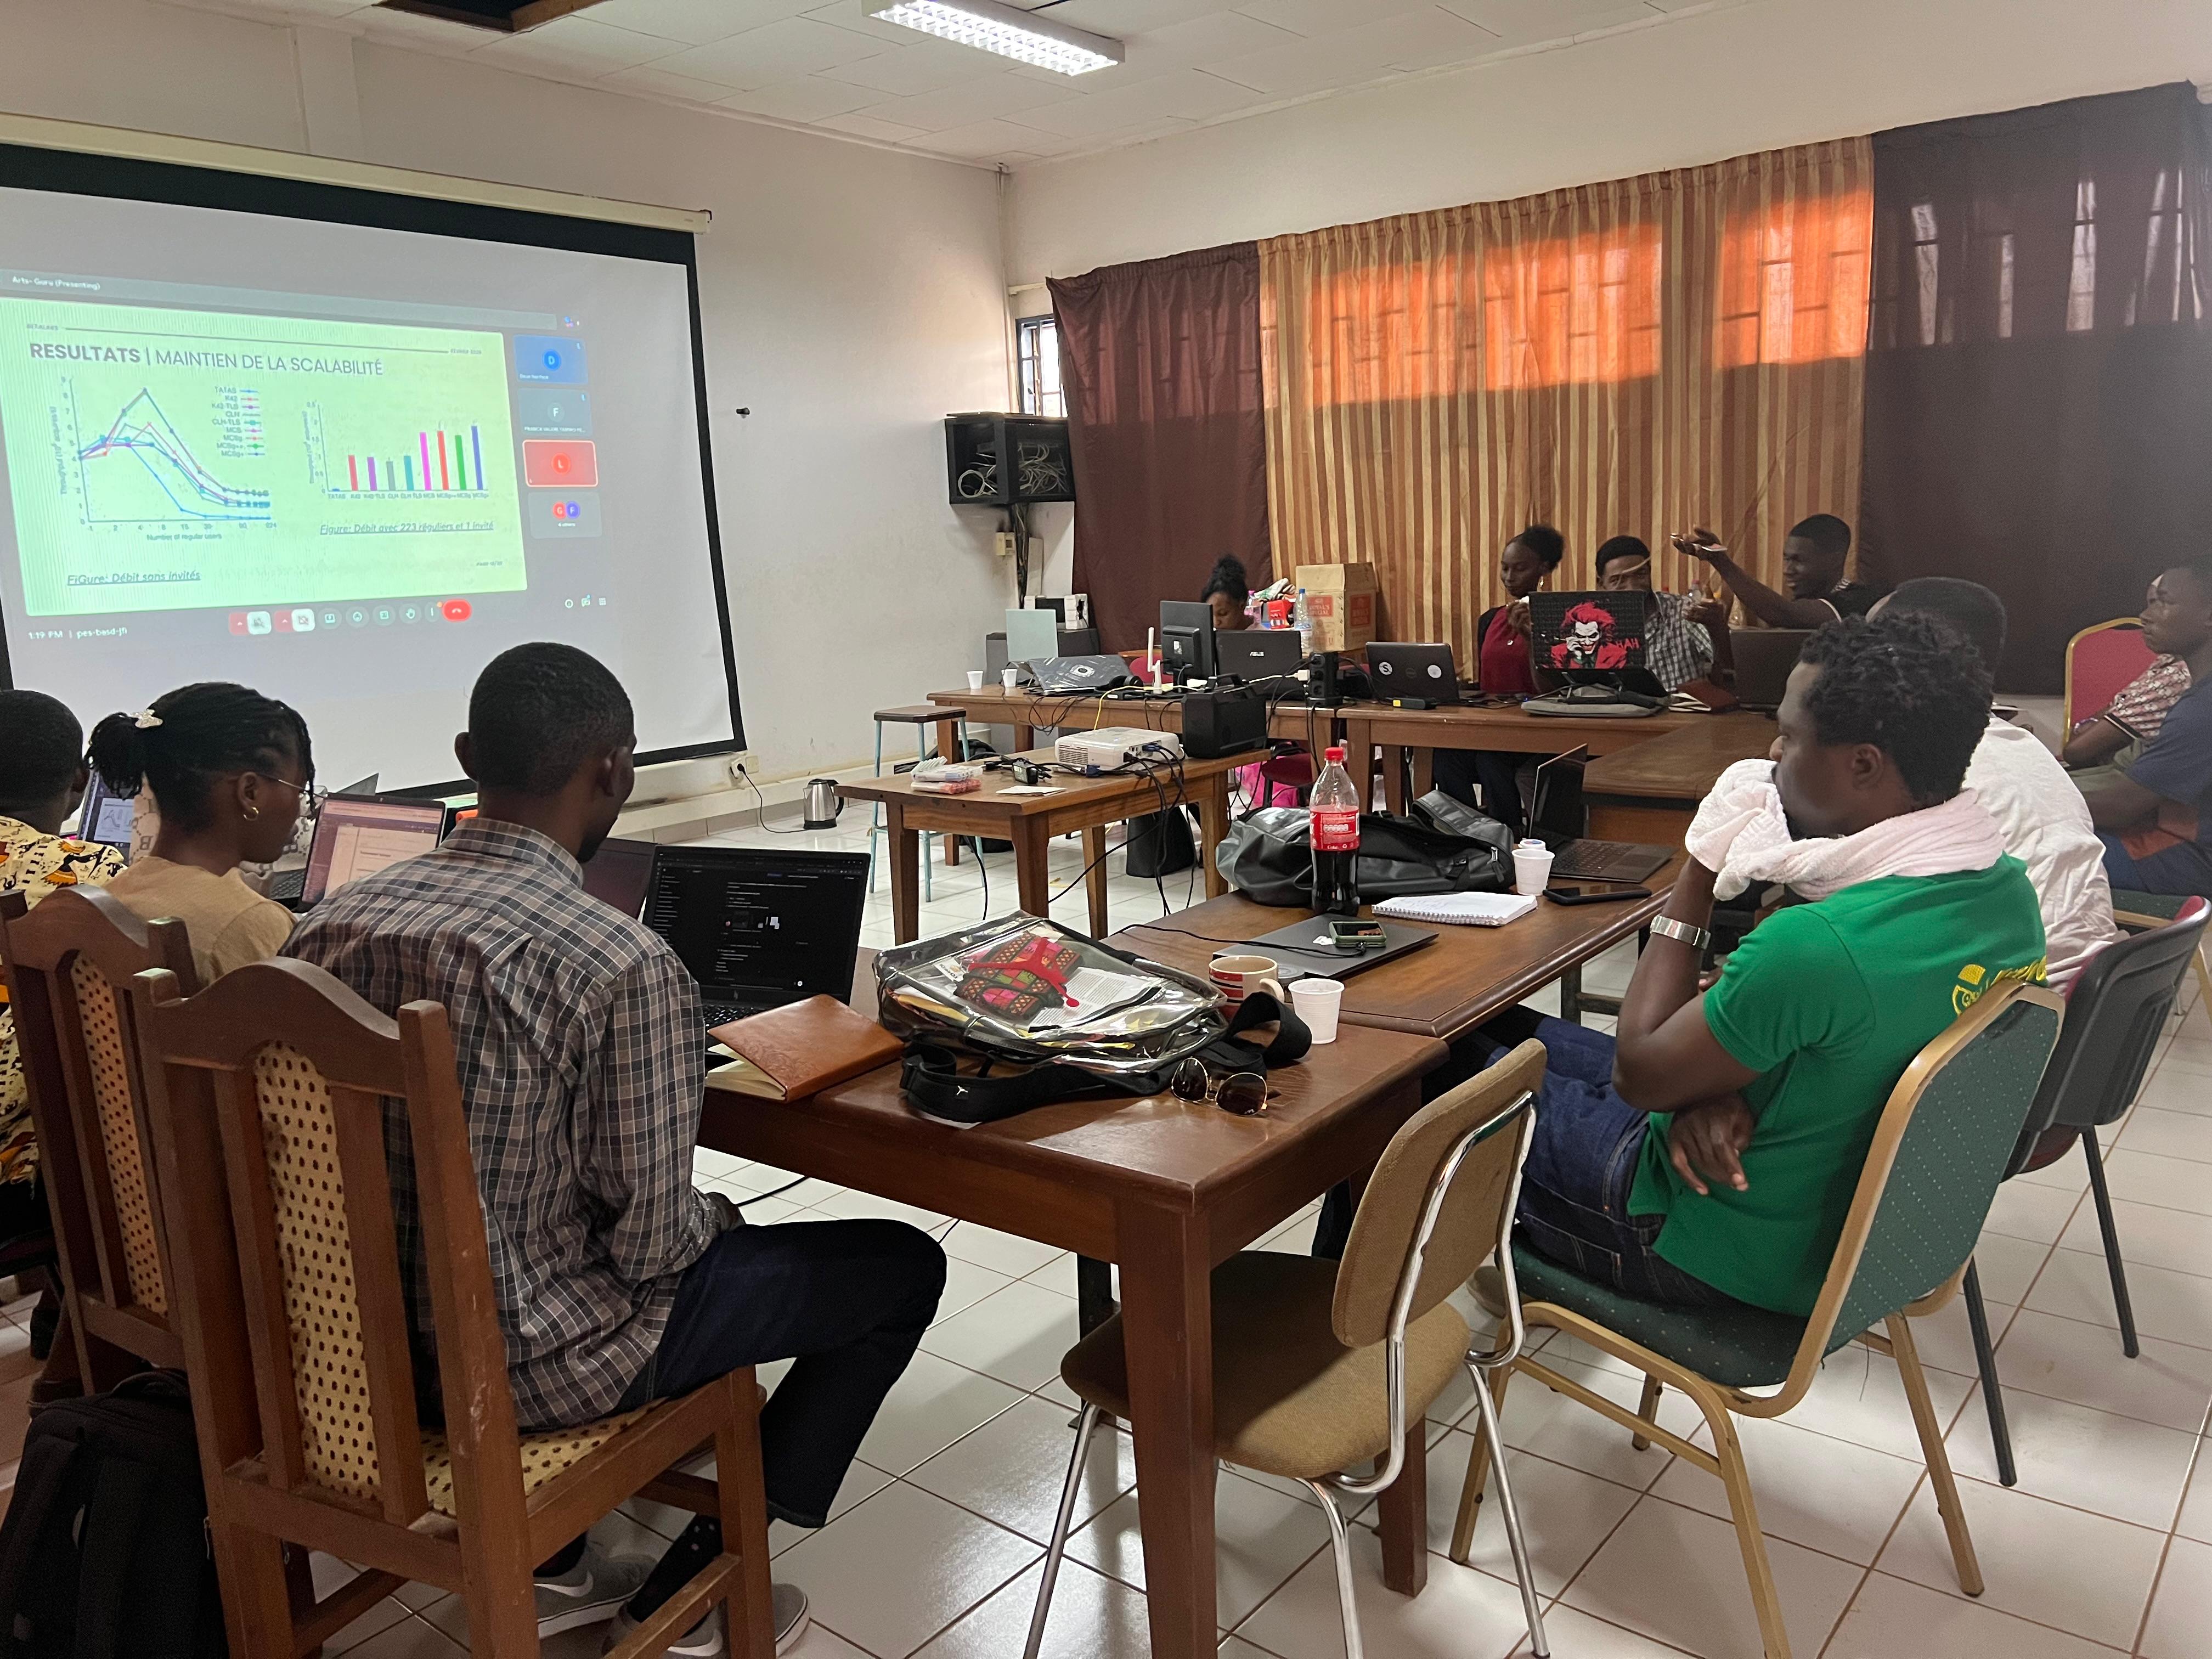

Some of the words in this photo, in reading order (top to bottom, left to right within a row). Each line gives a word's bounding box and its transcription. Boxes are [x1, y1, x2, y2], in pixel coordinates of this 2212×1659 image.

[30, 343, 140, 363] RESULTATS
[155, 349, 237, 368] MAINTIEN
[242, 354, 264, 369] DE
[268, 356, 287, 371] LA
[290, 358, 383, 375] SCALABILITÉ
[549, 356, 556, 365] D
[215, 386, 236, 394] TATAS
[552, 408, 559, 417] F
[558, 459, 563, 469] L
[320, 524, 352, 535] Figure:
[354, 524, 376, 533] Débit
[399, 523, 416, 532] 223
[112, 573, 139, 583] Débit
[168, 570, 201, 580] invités
